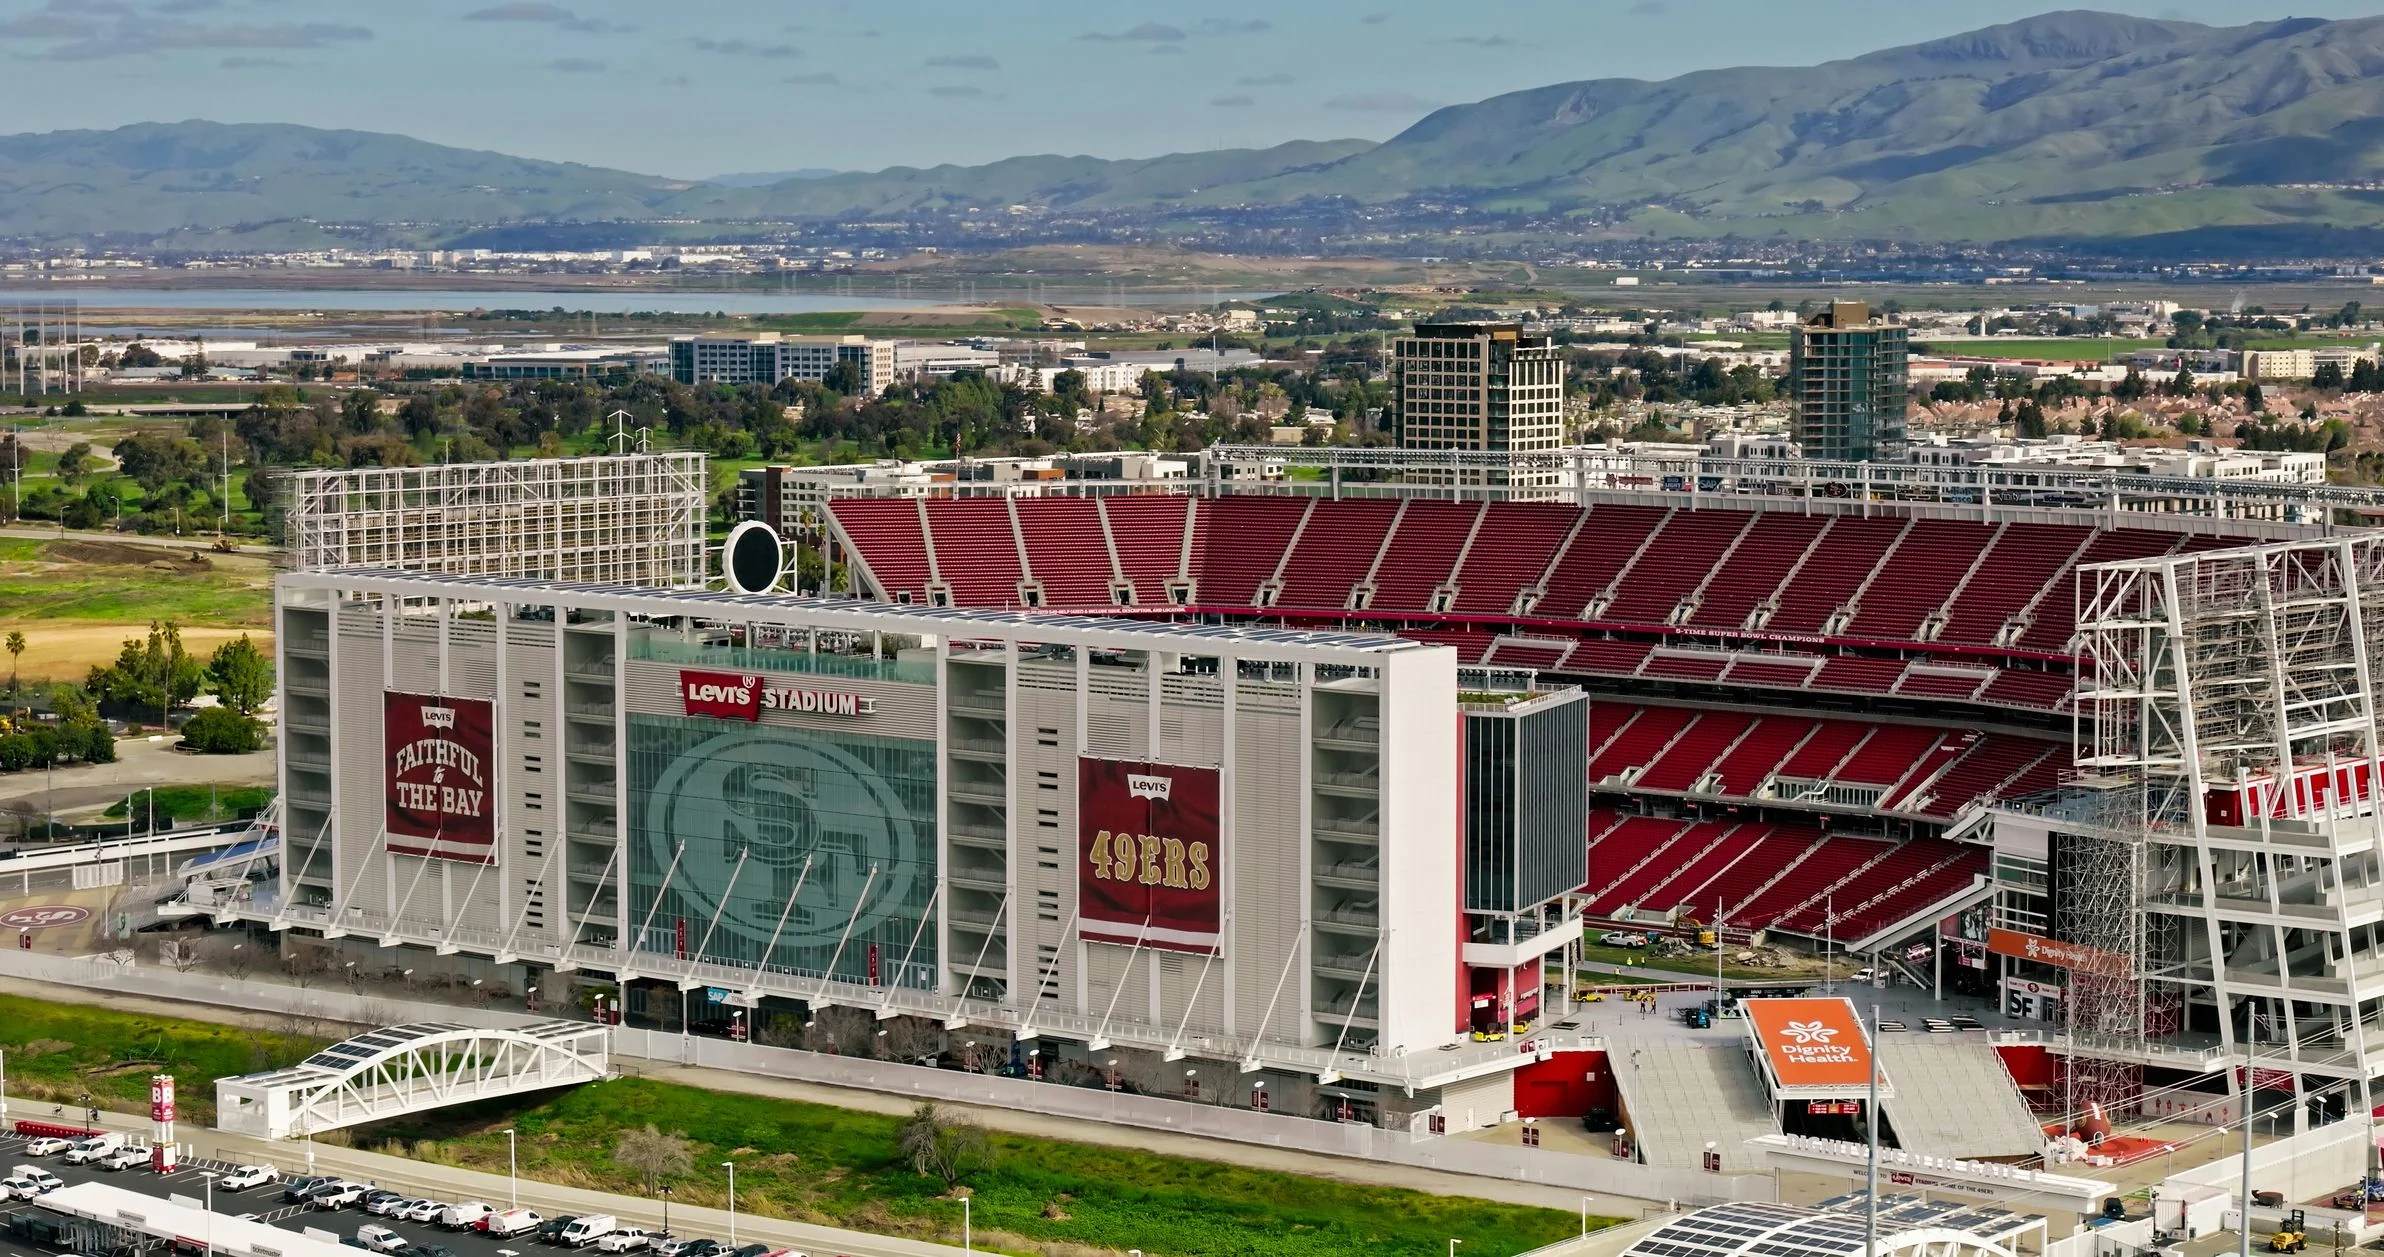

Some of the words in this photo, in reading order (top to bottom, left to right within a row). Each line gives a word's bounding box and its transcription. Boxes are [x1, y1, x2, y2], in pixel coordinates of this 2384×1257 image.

[1700, 480, 1717, 489] SAP
[1769, 634, 1825, 643] CHAMPIONS
[765, 688, 857, 715] STADIUM
[396, 738, 483, 788] FAITHFUL
[432, 766, 446, 784] to
[396, 782, 437, 811] THE
[442, 787, 484, 817] BAY
[1089, 830, 1211, 891] 49ERS
[2041, 946, 2065, 961] Dignity
[708, 990, 724, 1001] SAP
[2011, 990, 2033, 1017] SF
[1781, 1045, 1851, 1056] Dignity
[1789, 1054, 1853, 1063] Health
[152, 1086, 162, 1103] B
[1786, 1133, 1869, 1159] DIGNITY
[1977, 1187, 1994, 1195] 49ERS
[118, 1211, 145, 1223] ticketmaster
